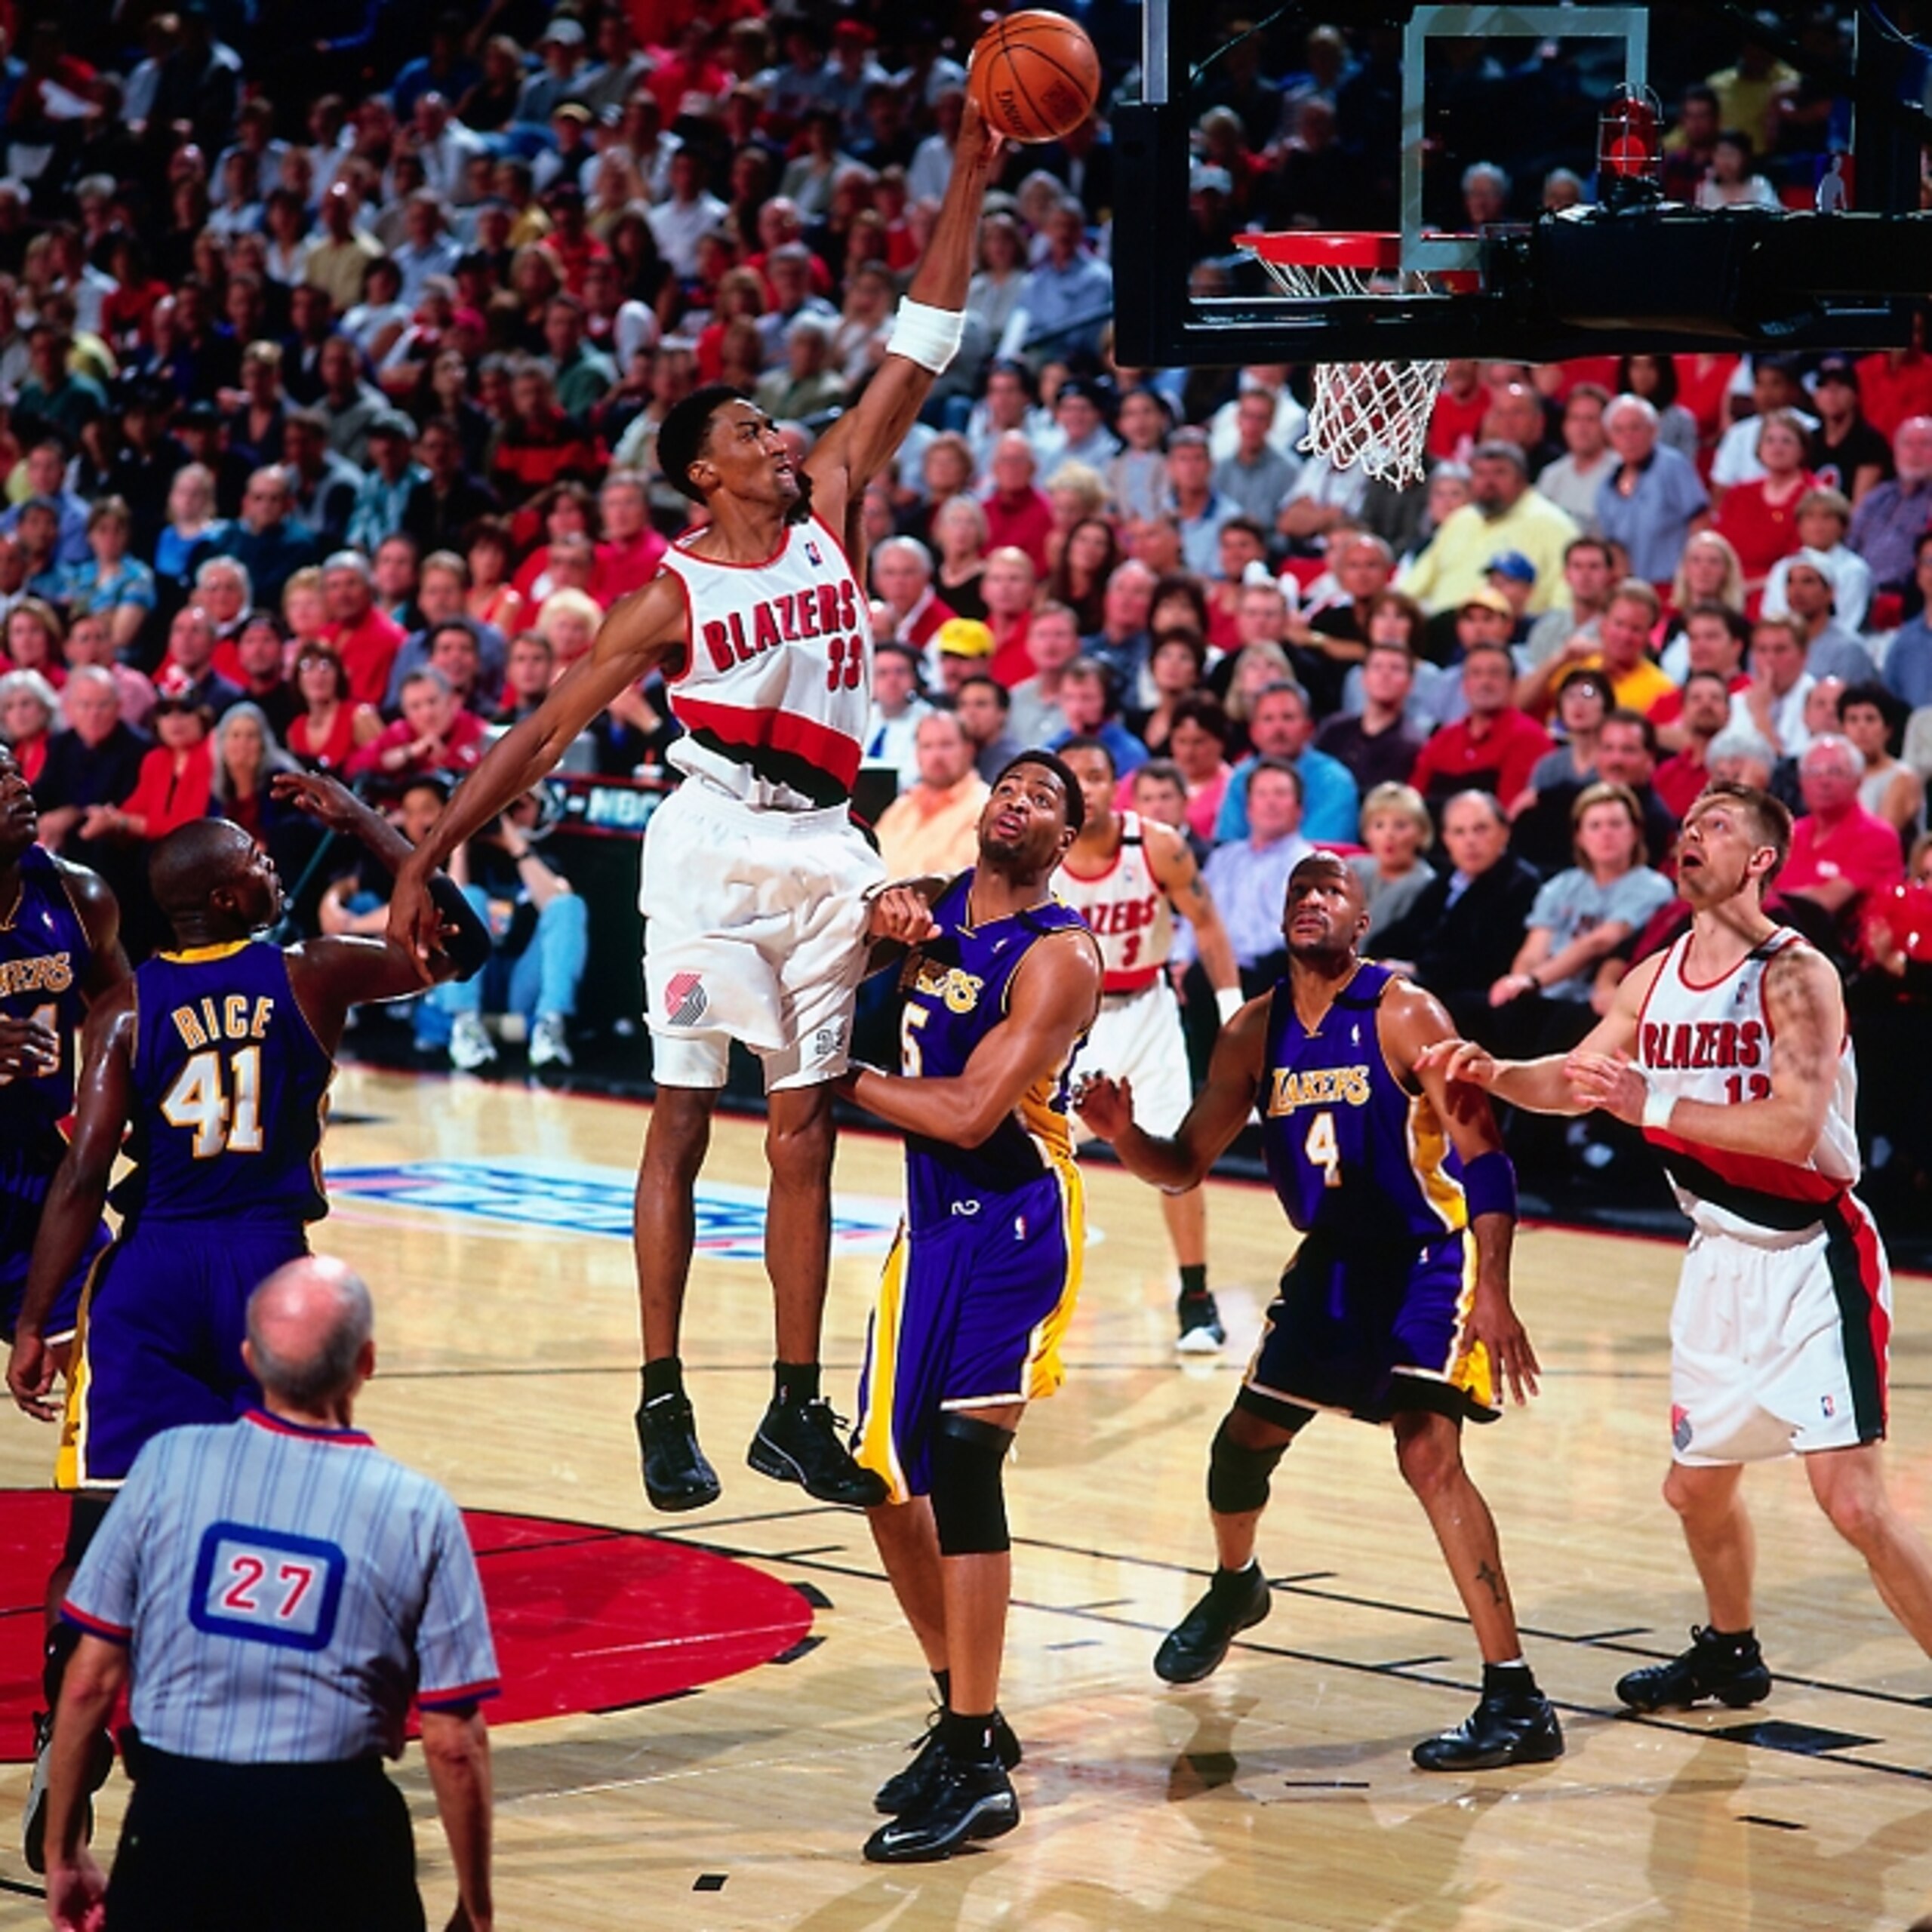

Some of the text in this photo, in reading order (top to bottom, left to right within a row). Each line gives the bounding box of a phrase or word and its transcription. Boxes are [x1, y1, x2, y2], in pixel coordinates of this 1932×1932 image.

[703, 579, 857, 674] BLAZERS
[827, 635, 863, 693] 33
[1121, 934, 1142, 968] 3
[171, 995, 275, 1051] RICE
[1643, 1020, 1762, 1069] BLAZERS
[159, 1045, 263, 1159] 41
[1266, 1065, 1371, 1118] LAKERS
[1305, 1111, 1343, 1188] 4
[225, 1555, 313, 1617] 27
